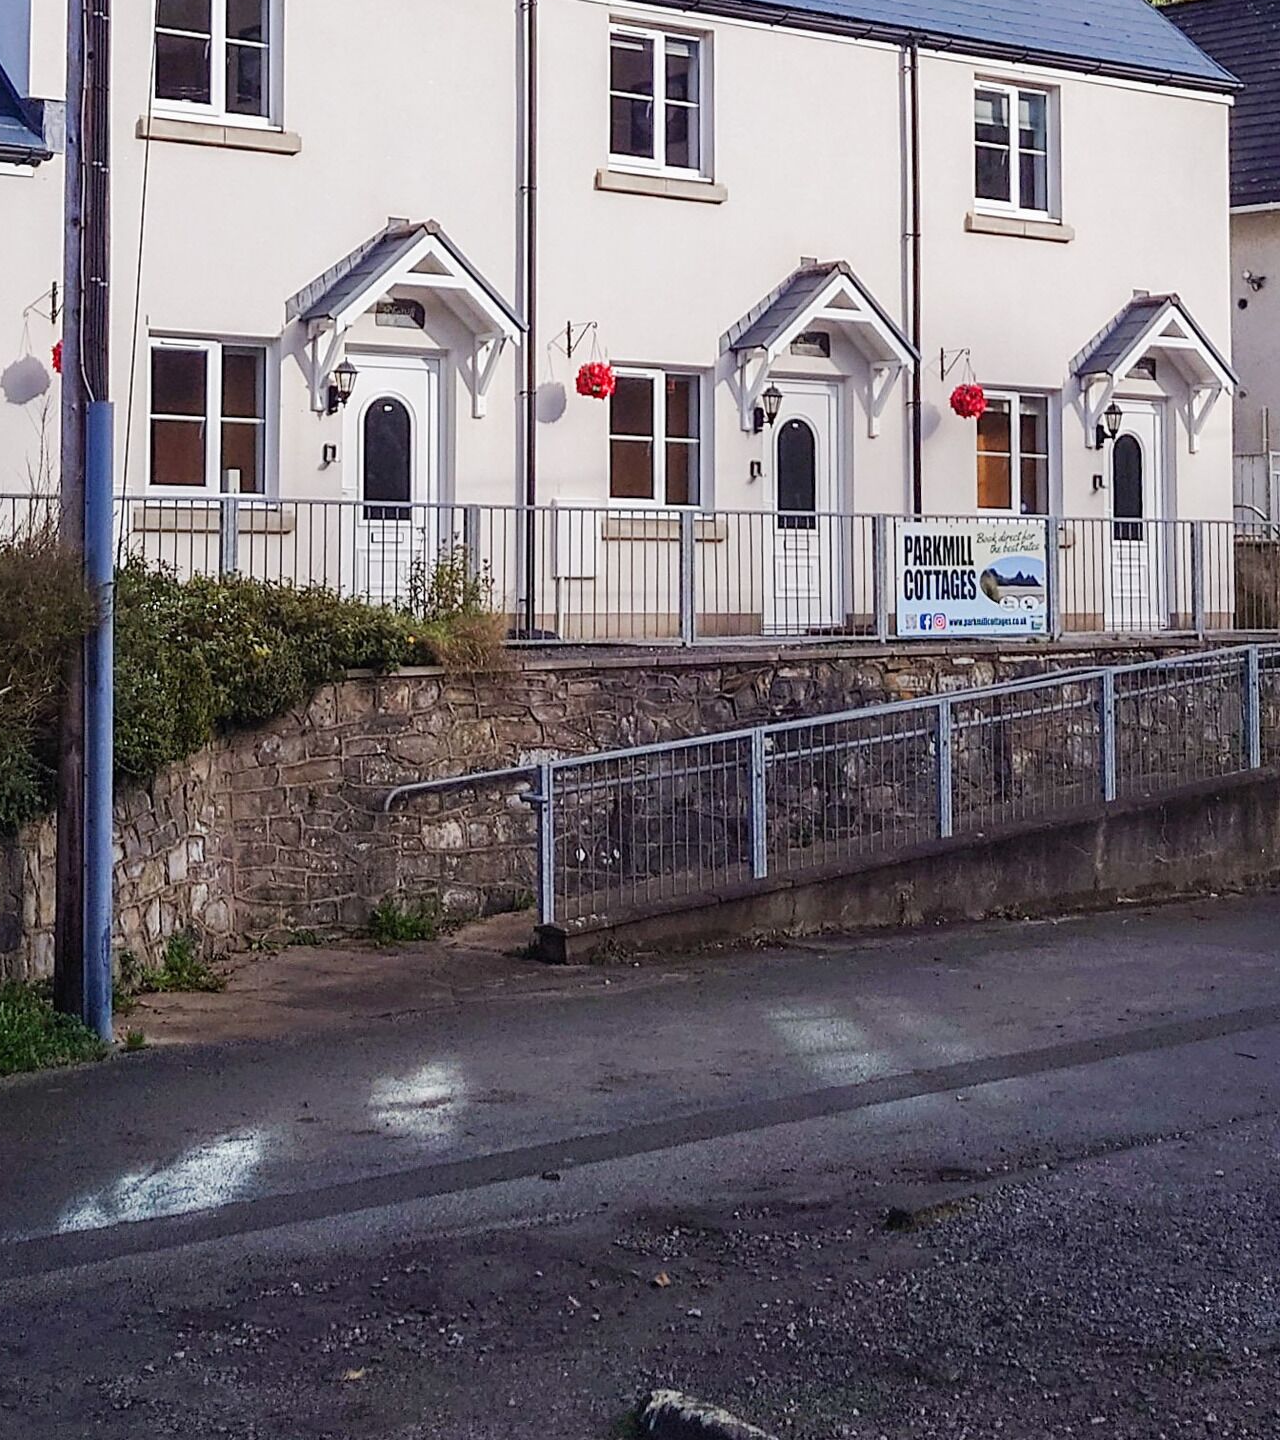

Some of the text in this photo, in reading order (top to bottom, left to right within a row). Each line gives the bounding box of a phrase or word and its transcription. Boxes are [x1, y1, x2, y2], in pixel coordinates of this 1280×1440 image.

[976, 528, 1035, 545] Book direct for
[904, 535, 974, 566] PARKMILL
[990, 541, 1040, 554] the best rates
[903, 569, 977, 601] COTTAGES
[949, 616, 1027, 627] www.parkmillcottages.co.uk
